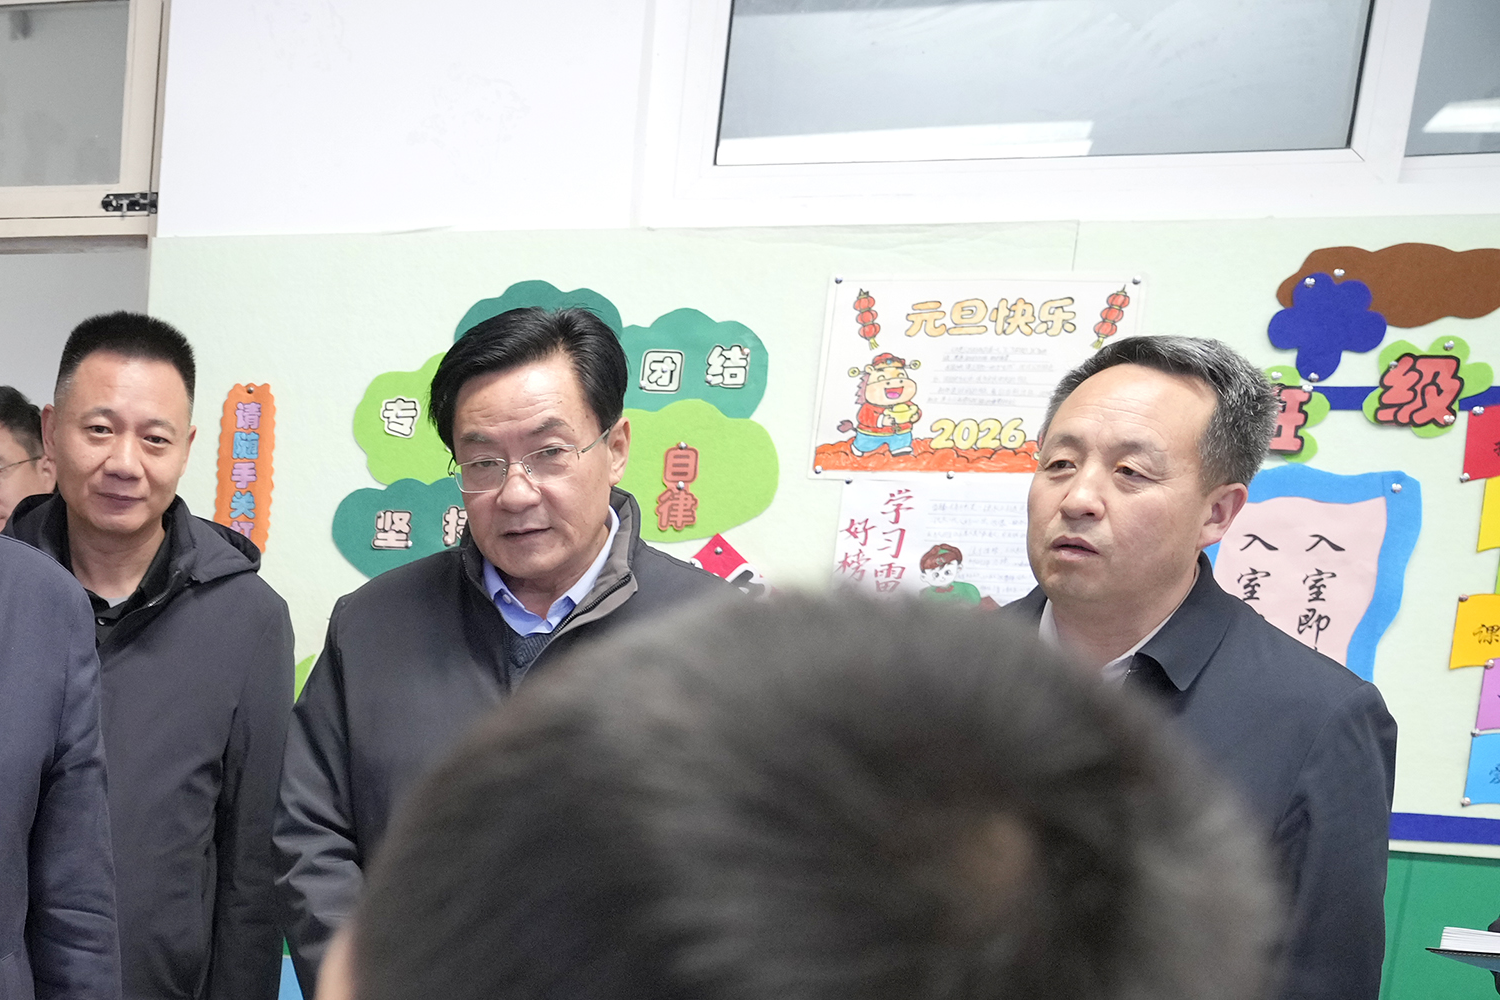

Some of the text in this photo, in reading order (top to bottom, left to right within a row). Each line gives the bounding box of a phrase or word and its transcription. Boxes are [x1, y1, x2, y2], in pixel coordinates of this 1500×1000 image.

[904, 296, 1077, 337] 元旦快乐
[639, 344, 751, 394] 团结
[380, 397, 420, 438] 专
[929, 417, 1027, 451] 2026
[655, 442, 700, 532] 自律
[1298, 534, 1346, 650] 入室即
